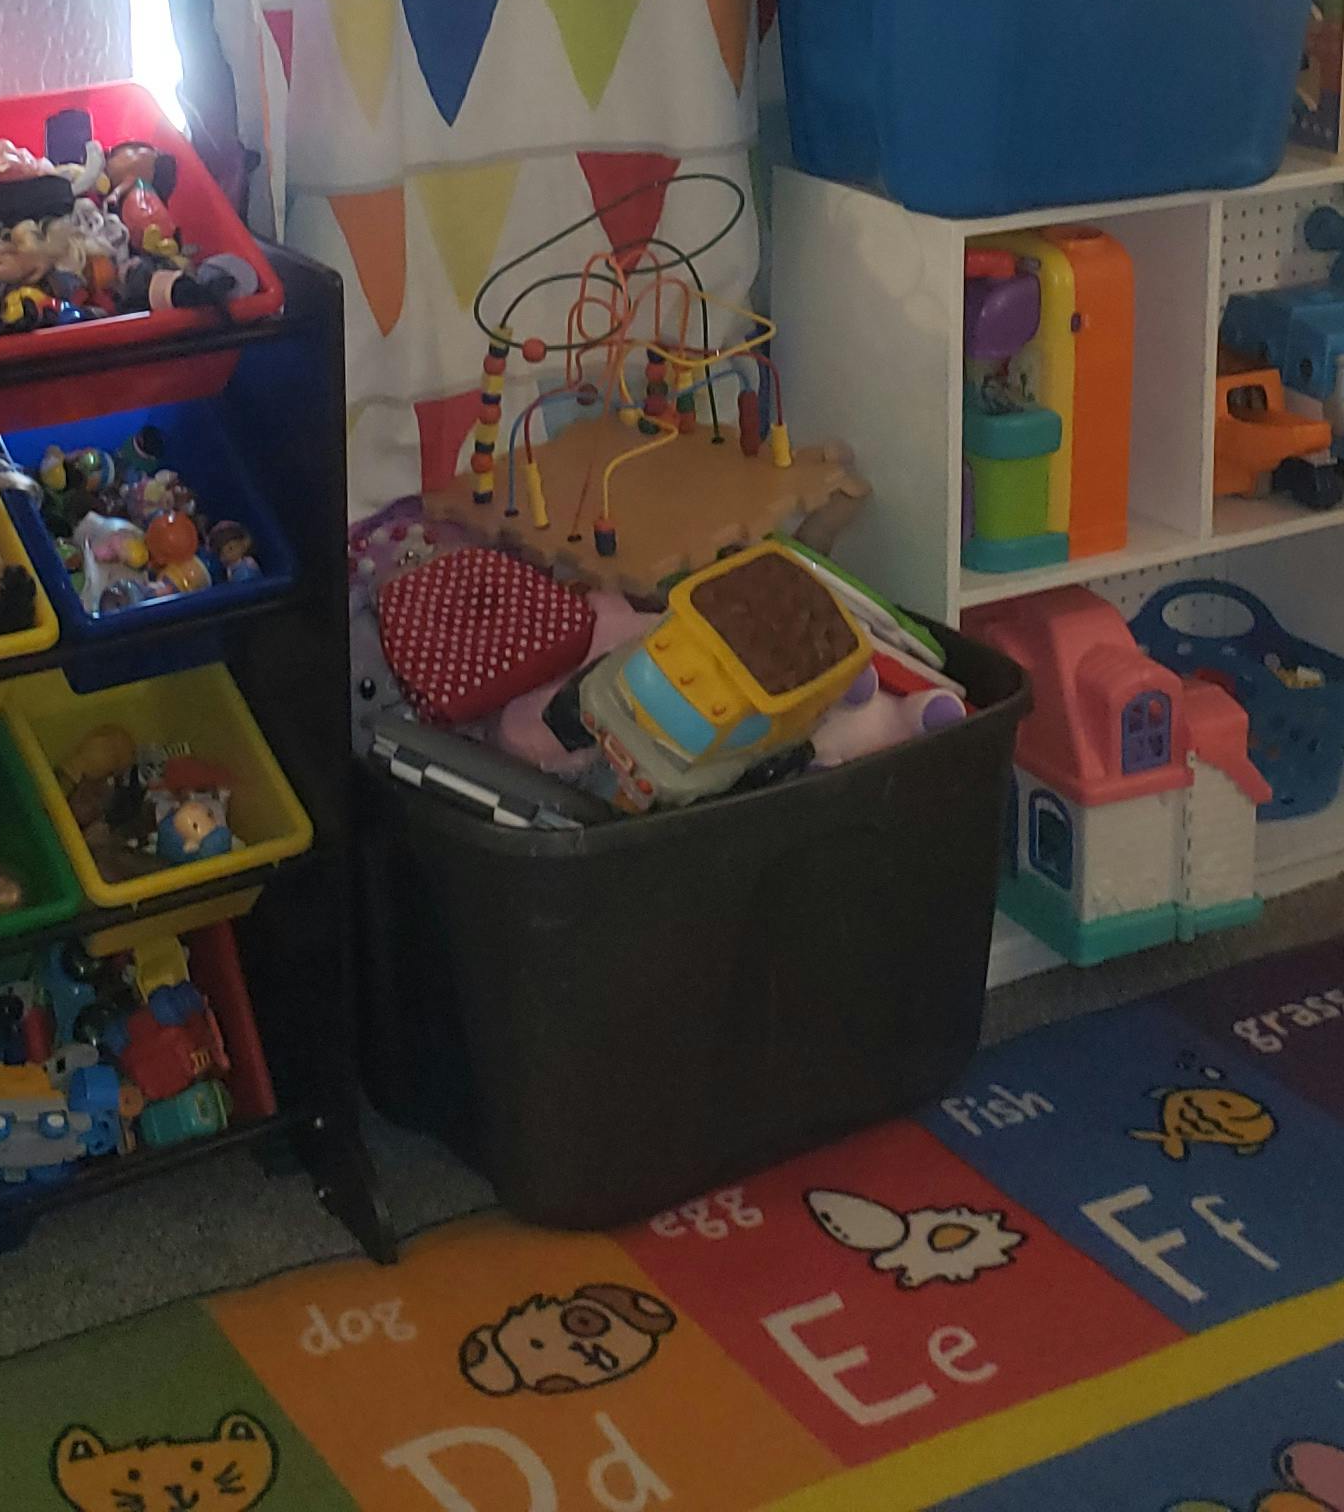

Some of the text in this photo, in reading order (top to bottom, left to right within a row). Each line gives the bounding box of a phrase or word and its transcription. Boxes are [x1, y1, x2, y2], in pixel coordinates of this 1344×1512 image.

[940, 1083, 1055, 1138] fish
[649, 1186, 764, 1241] egg
[299, 1298, 418, 1357] dog
